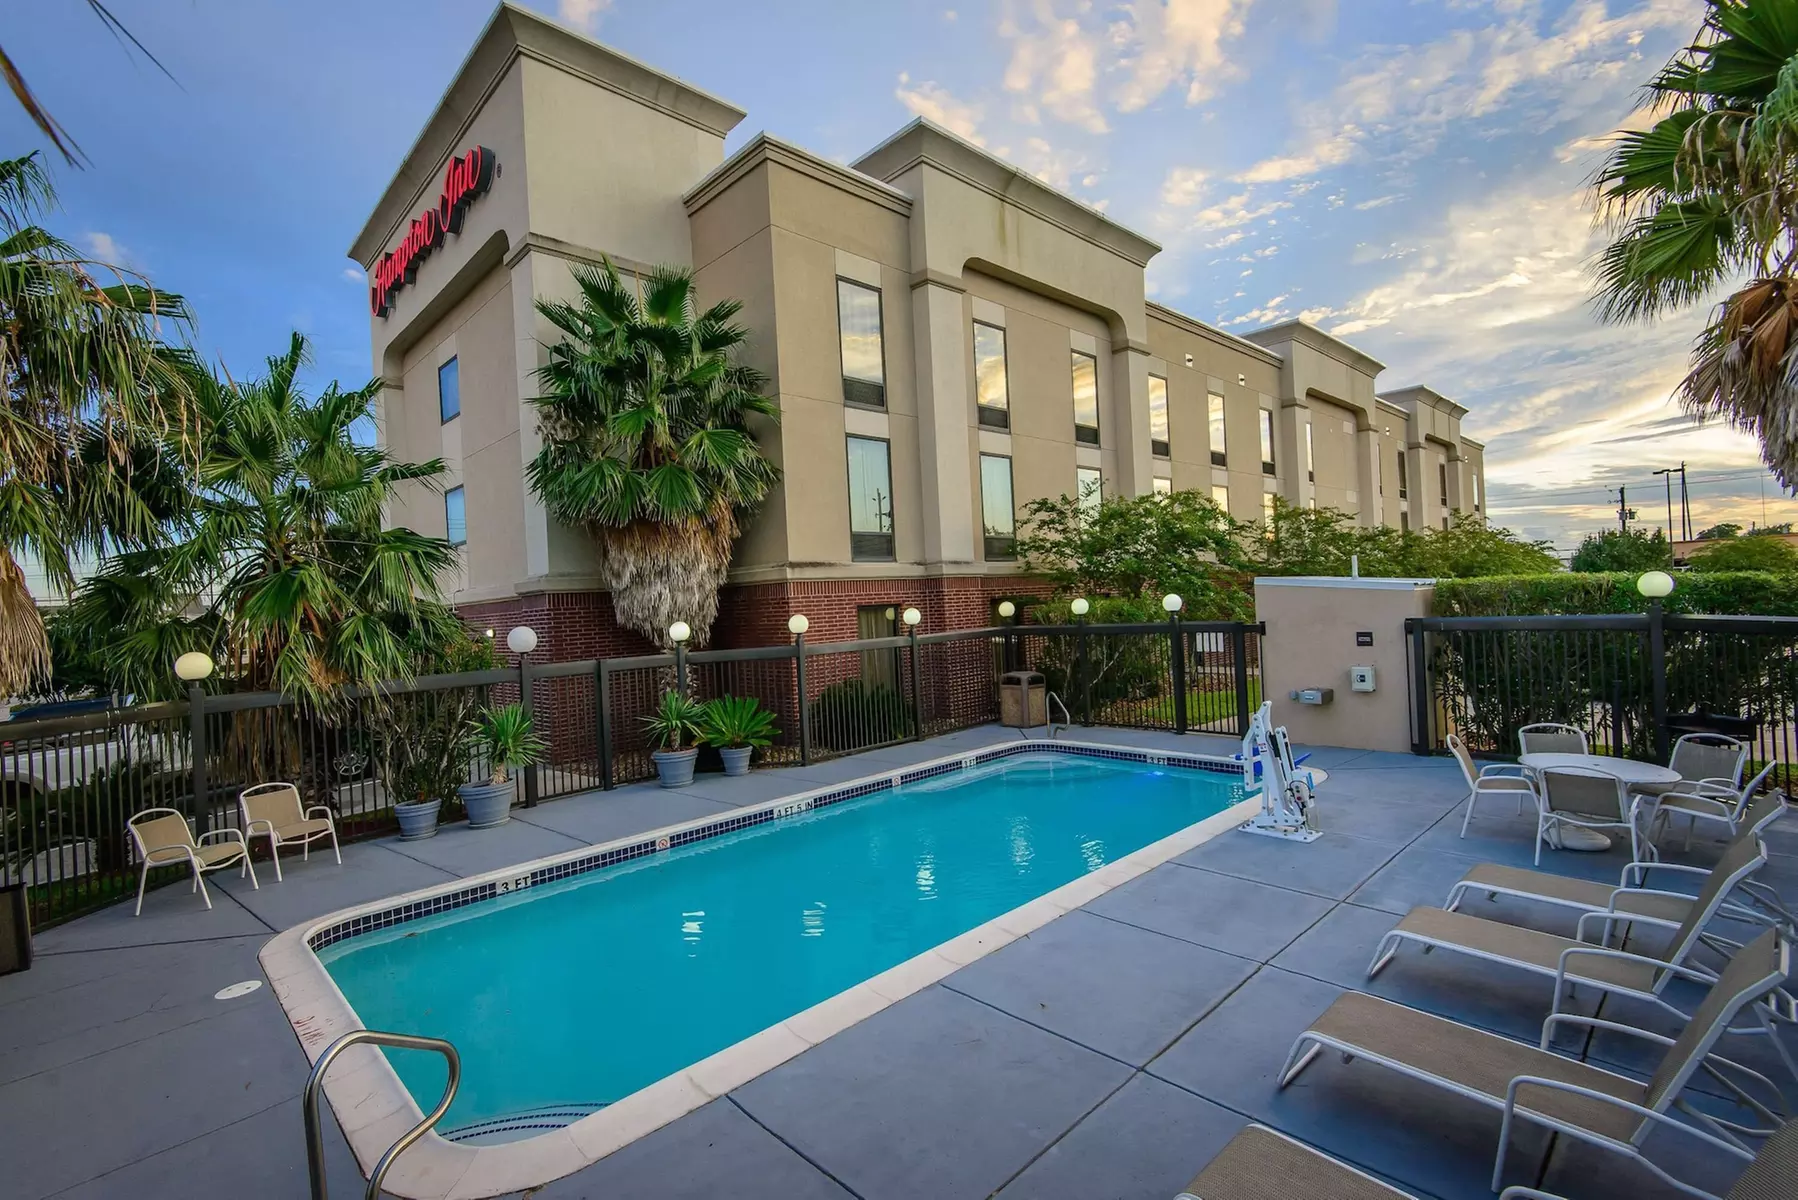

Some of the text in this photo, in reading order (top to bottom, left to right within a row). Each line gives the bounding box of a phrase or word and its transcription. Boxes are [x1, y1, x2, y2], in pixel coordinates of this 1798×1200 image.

[370, 144, 482, 316] Hampton Inn
[777, 801, 813, 817] 4 FT 5 IN
[501, 875, 530, 892] 3 FT
